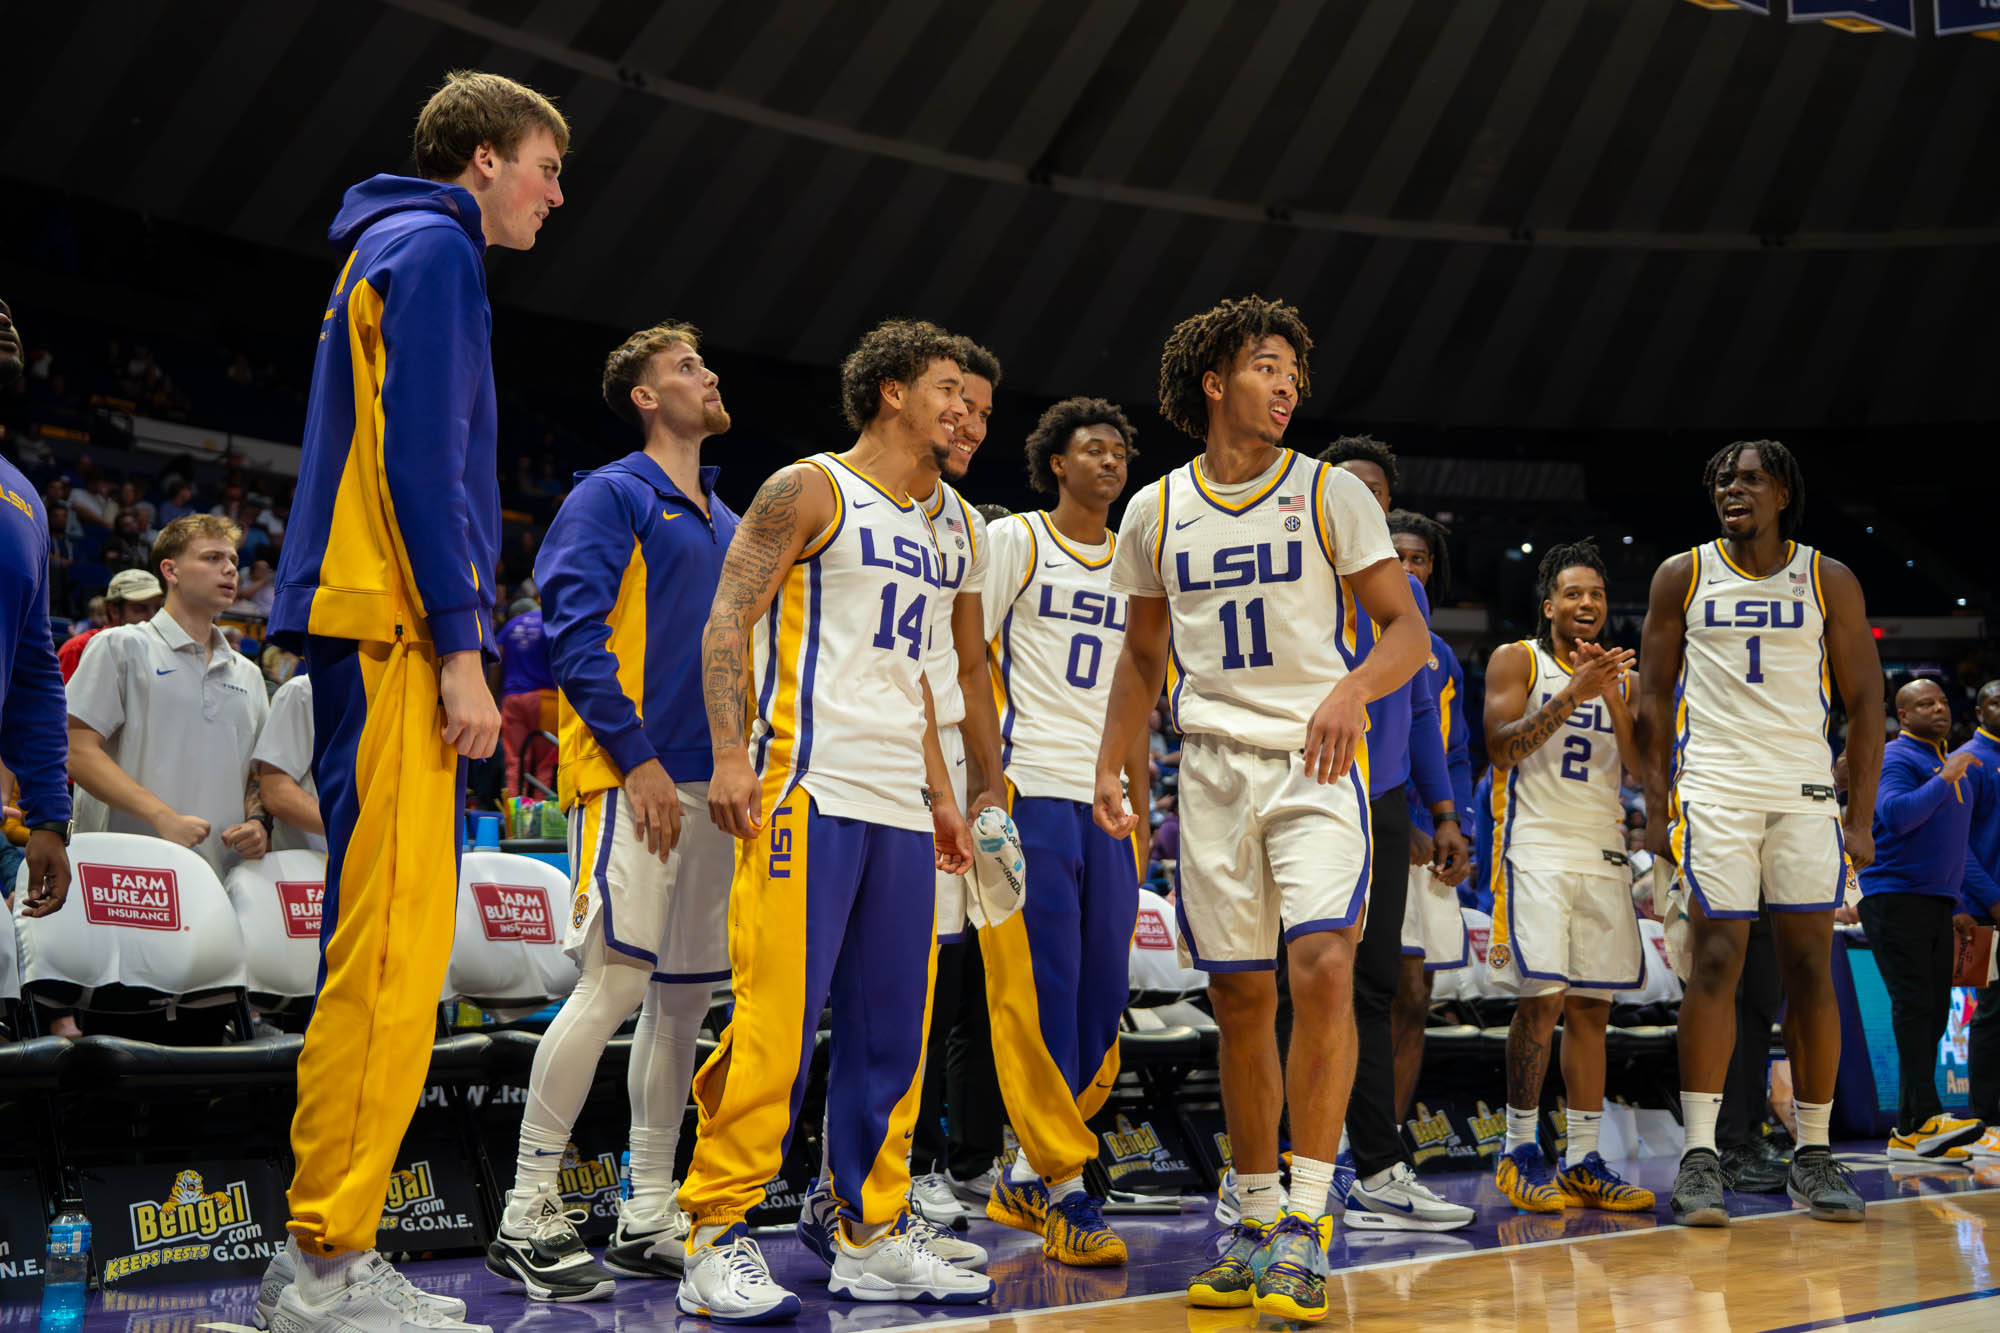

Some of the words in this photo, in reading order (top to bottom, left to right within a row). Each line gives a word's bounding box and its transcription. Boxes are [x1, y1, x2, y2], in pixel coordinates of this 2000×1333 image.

[859, 527, 941, 590] LSU
[1176, 541, 1302, 592] LSU
[873, 582, 927, 661] 14
[1038, 584, 1129, 632] LSU
[1704, 600, 1804, 629] LSU
[1218, 597, 1274, 670] 11
[1066, 632, 1103, 690] 0
[1746, 635, 1764, 683] 1
[1560, 734, 1592, 782] 2
[769, 806, 793, 879] LSU
[91, 886, 169, 907] BUREAU
[111, 873, 167, 891] FARM
[306, 888, 325, 901] FA
[107, 907, 170, 922] INSURANCE
[289, 903, 323, 917] BUR
[1138, 914, 1161, 924] ARM
[386, 1164, 433, 1209] gal
[557, 1155, 619, 1197] ngal
[133, 1184, 248, 1246] Bengal
[401, 1214, 474, 1232] G.O.N.E.
[410, 1198, 445, 1218] .com
[223, 1223, 263, 1246] .com
[104, 1250, 160, 1283] KEEPS
[162, 1244, 210, 1264] PESTS
[213, 1241, 286, 1262] G.O.N.E
